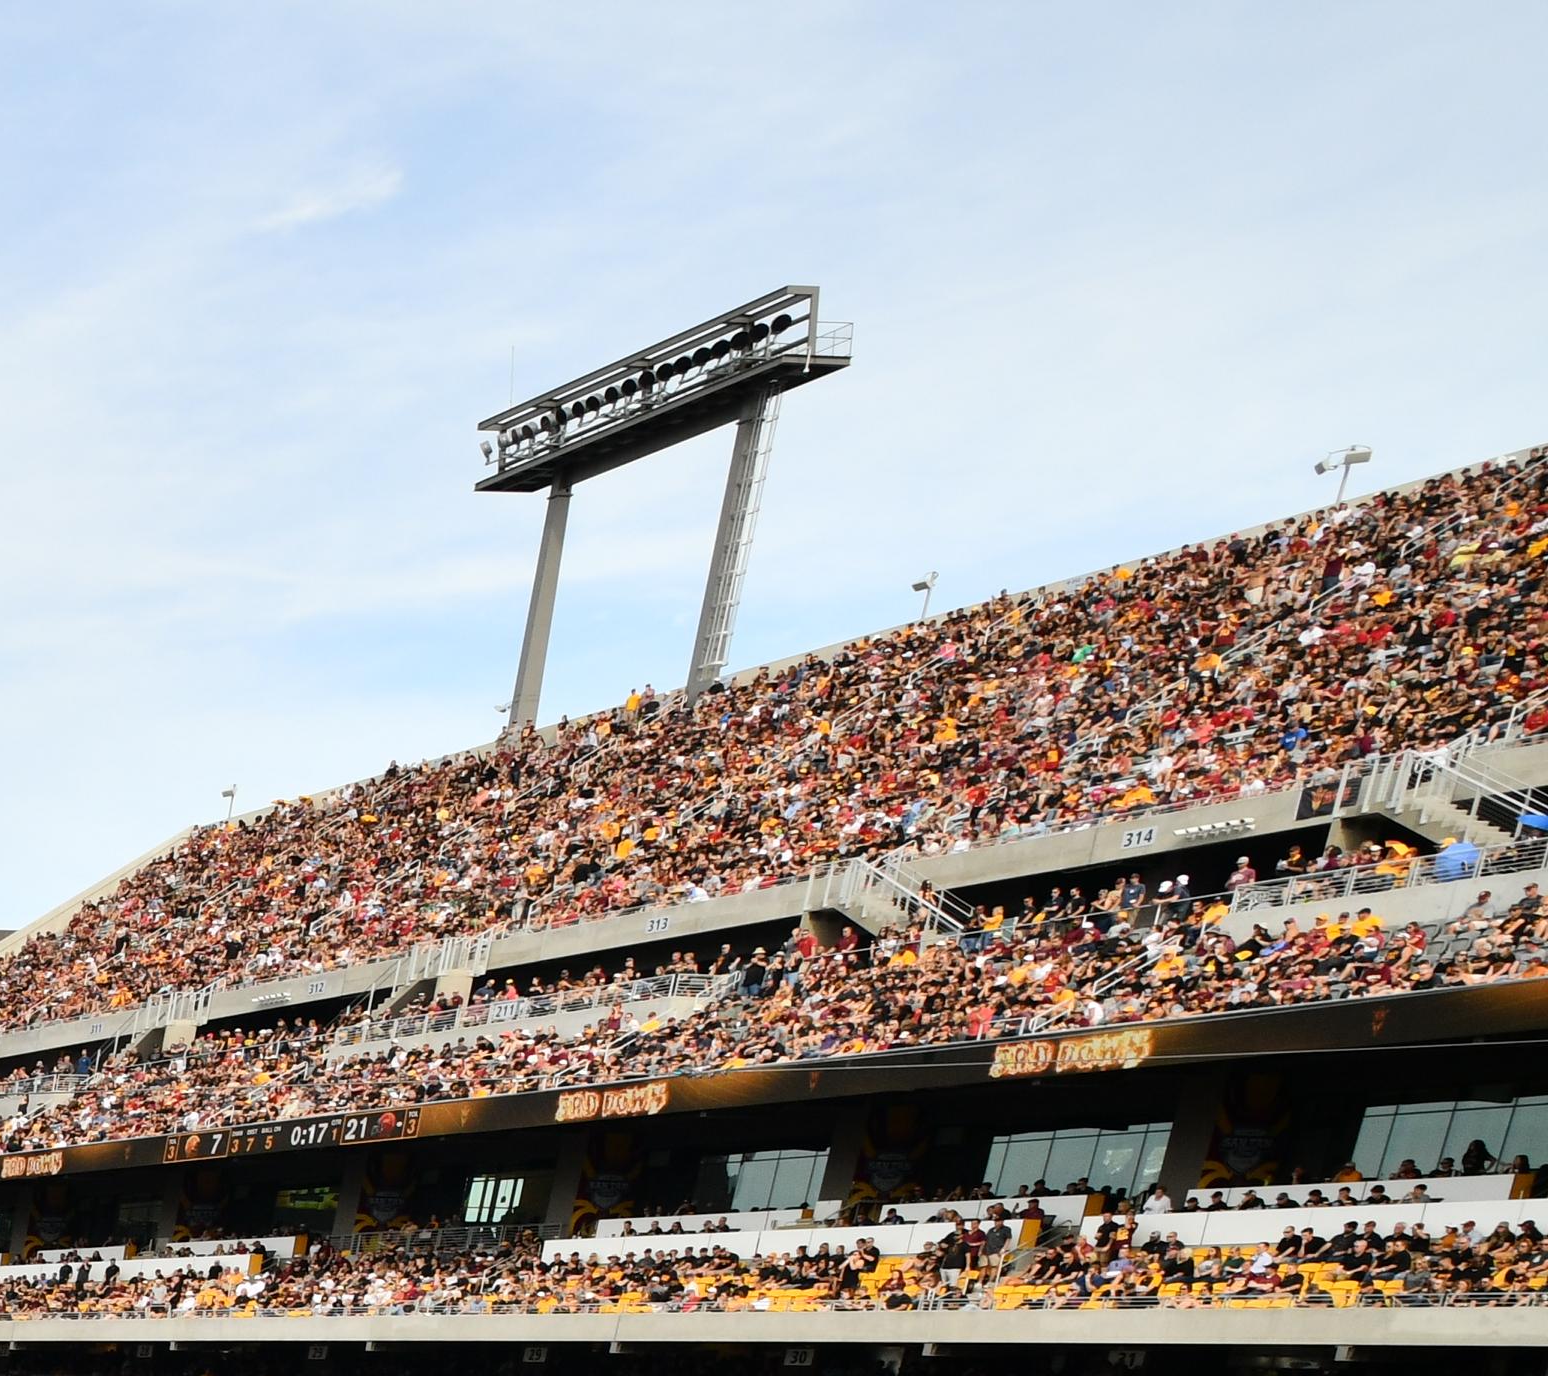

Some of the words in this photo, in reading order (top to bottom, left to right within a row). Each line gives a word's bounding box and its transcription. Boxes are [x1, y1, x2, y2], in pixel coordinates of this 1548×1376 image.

[1122, 829, 1155, 848] 314
[648, 918, 669, 932] 313
[309, 982, 324, 994] 312
[496, 1004, 514, 1018] 211
[291, 1123, 329, 1146] 0:17
[344, 1117, 368, 1140] 21
[211, 1133, 222, 1154] 7
[231, 1138, 239, 1153] 3
[246, 1137, 255, 1152] 7
[265, 1135, 273, 1150] 5
[791, 1351, 806, 1364] 30
